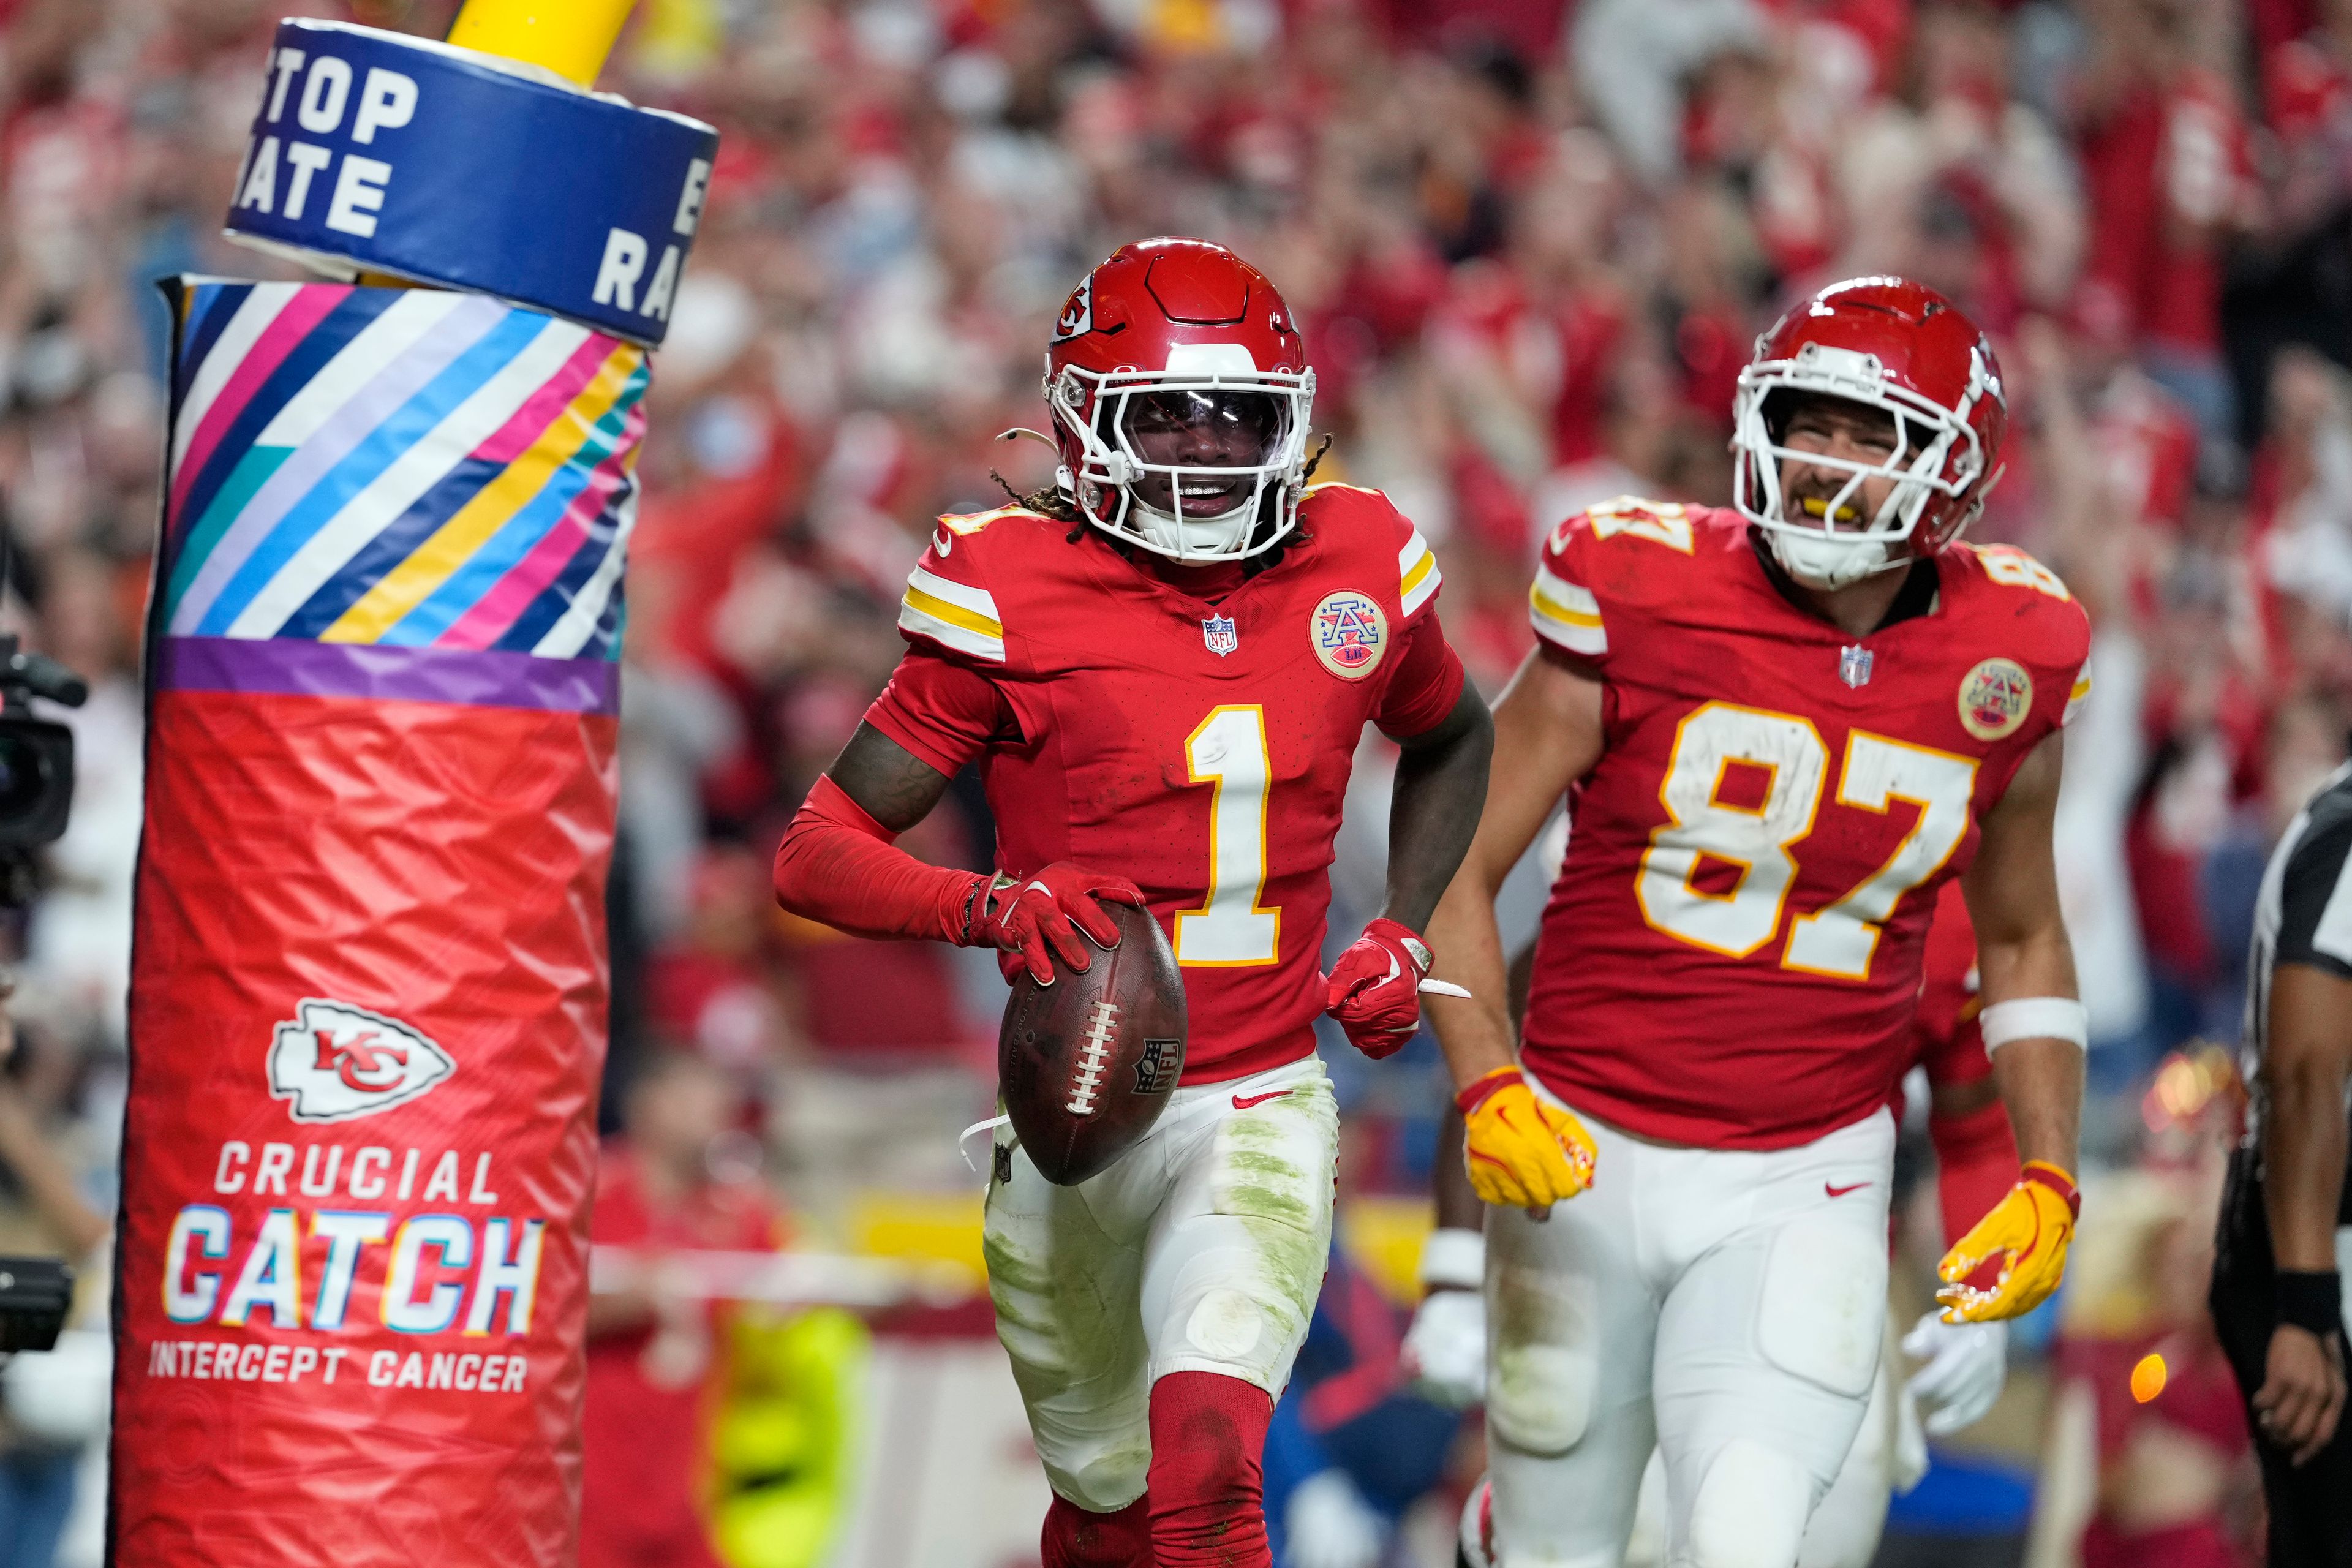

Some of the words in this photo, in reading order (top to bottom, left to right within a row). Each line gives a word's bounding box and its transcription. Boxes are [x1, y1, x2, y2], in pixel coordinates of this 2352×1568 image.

[266, 46, 420, 145] TOP
[232, 134, 393, 239] ATE
[1210, 632, 1233, 649] NFL
[1172, 703, 1282, 967] 1
[1633, 699, 1981, 981] 87
[1152, 1045, 1178, 1089] NFL
[214, 1140, 499, 1204] CRUCIAL
[161, 1203, 545, 1338] CATCH
[148, 1340, 347, 1384] INTERCEPT
[368, 1349, 529, 1393] CANCER
